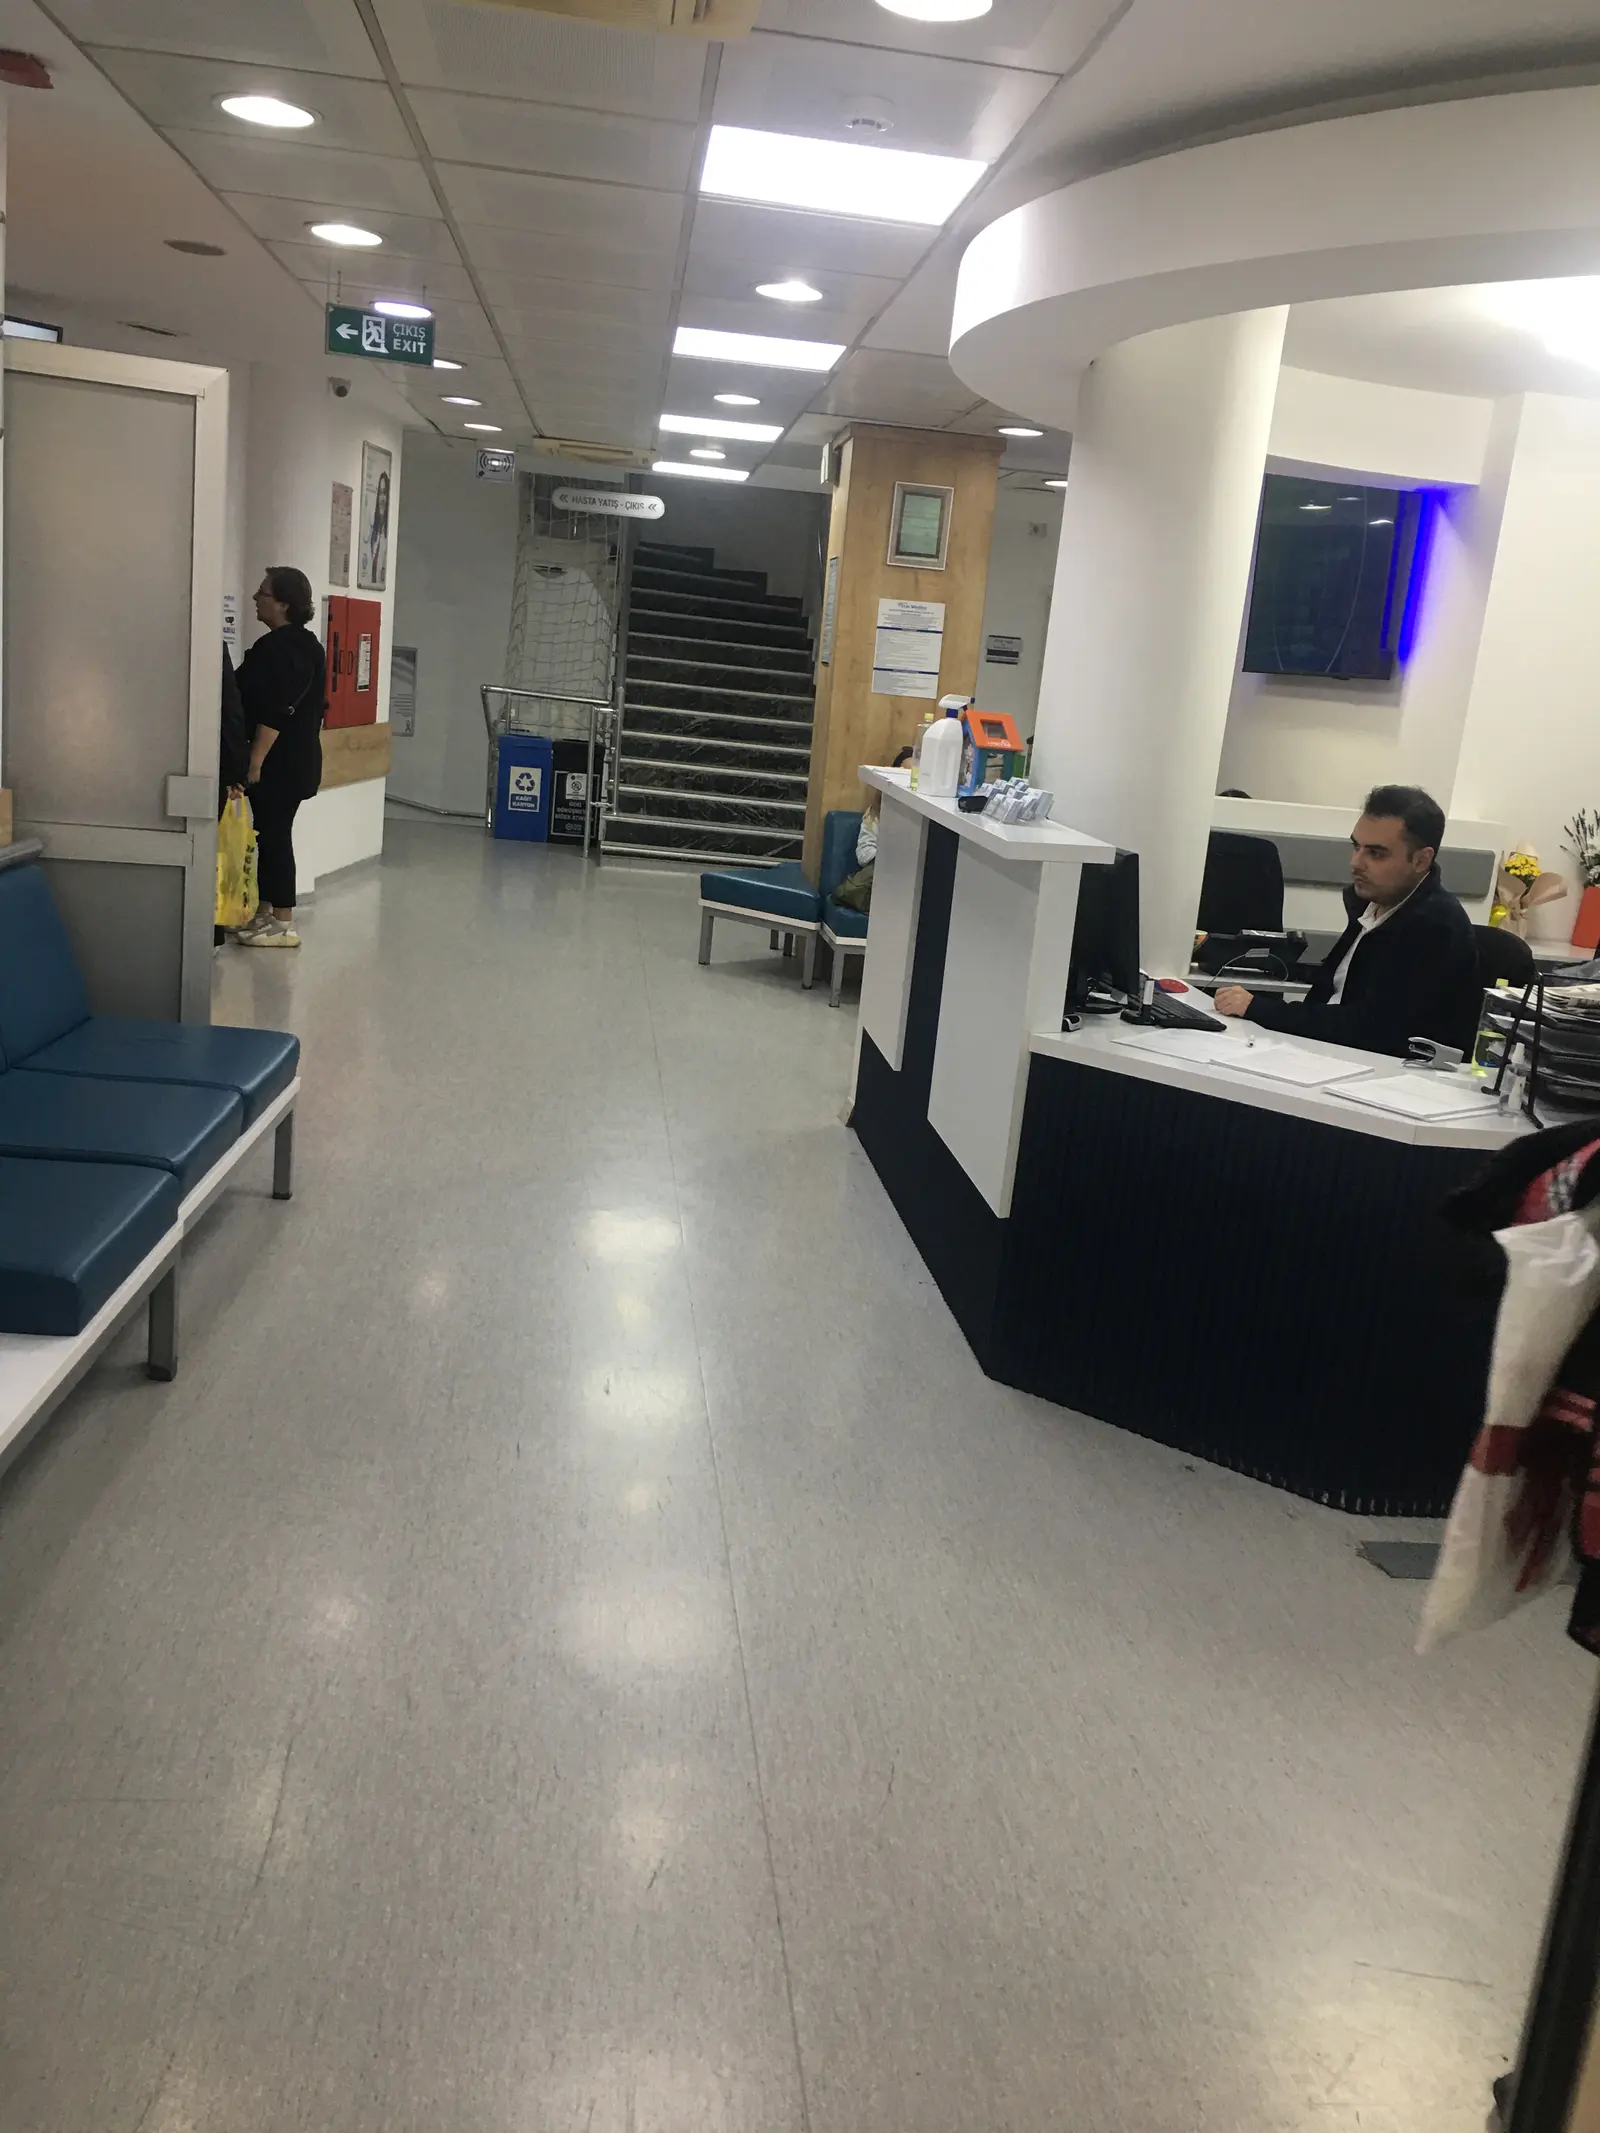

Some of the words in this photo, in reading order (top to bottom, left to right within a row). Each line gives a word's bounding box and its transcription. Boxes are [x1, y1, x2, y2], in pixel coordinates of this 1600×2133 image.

[393, 323, 426, 341] ÇIKIŞ
[393, 338, 427, 354] EXIT
[571, 495, 597, 506] HASTA
[599, 498, 619, 509] YATIŞ
